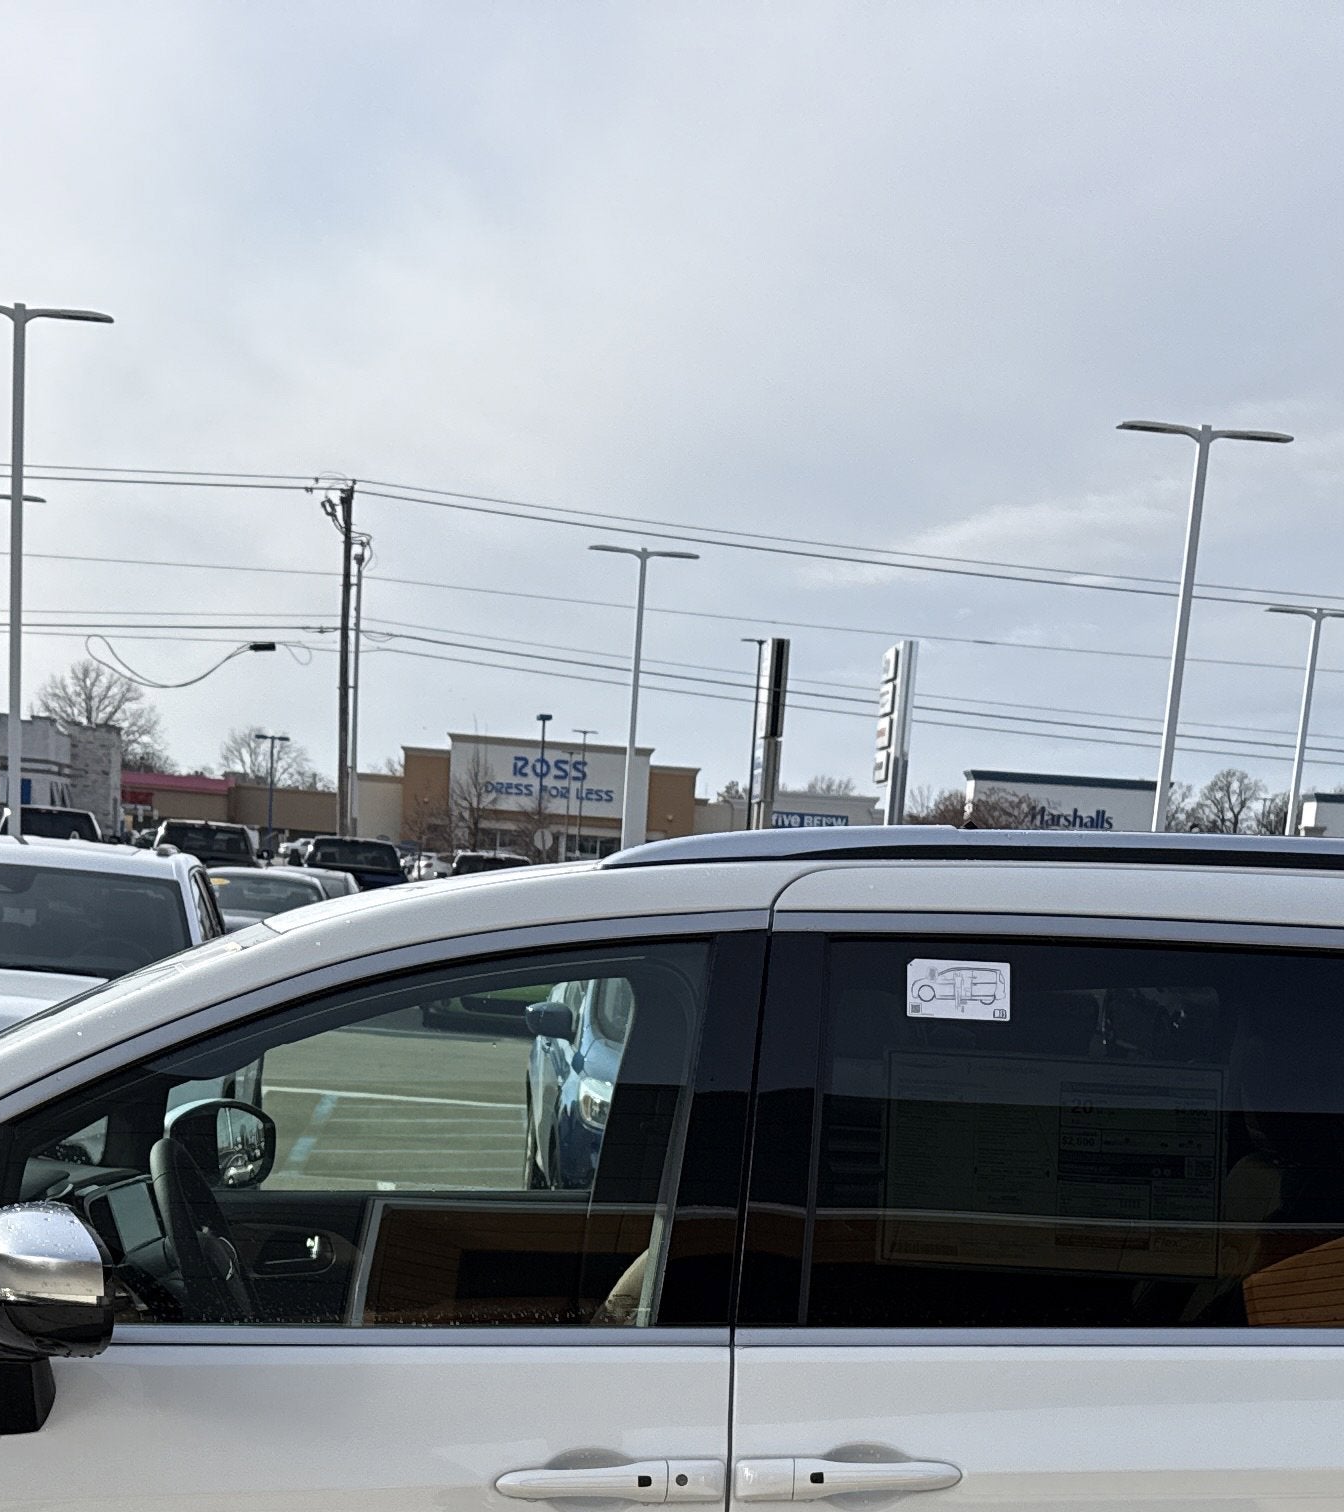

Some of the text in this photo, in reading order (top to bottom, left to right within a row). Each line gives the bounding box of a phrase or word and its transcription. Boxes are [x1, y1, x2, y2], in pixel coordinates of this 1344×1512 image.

[513, 756, 588, 781] ROSS
[485, 781, 614, 802] DRESS FOR LESS
[1029, 805, 1113, 829] Marshalls
